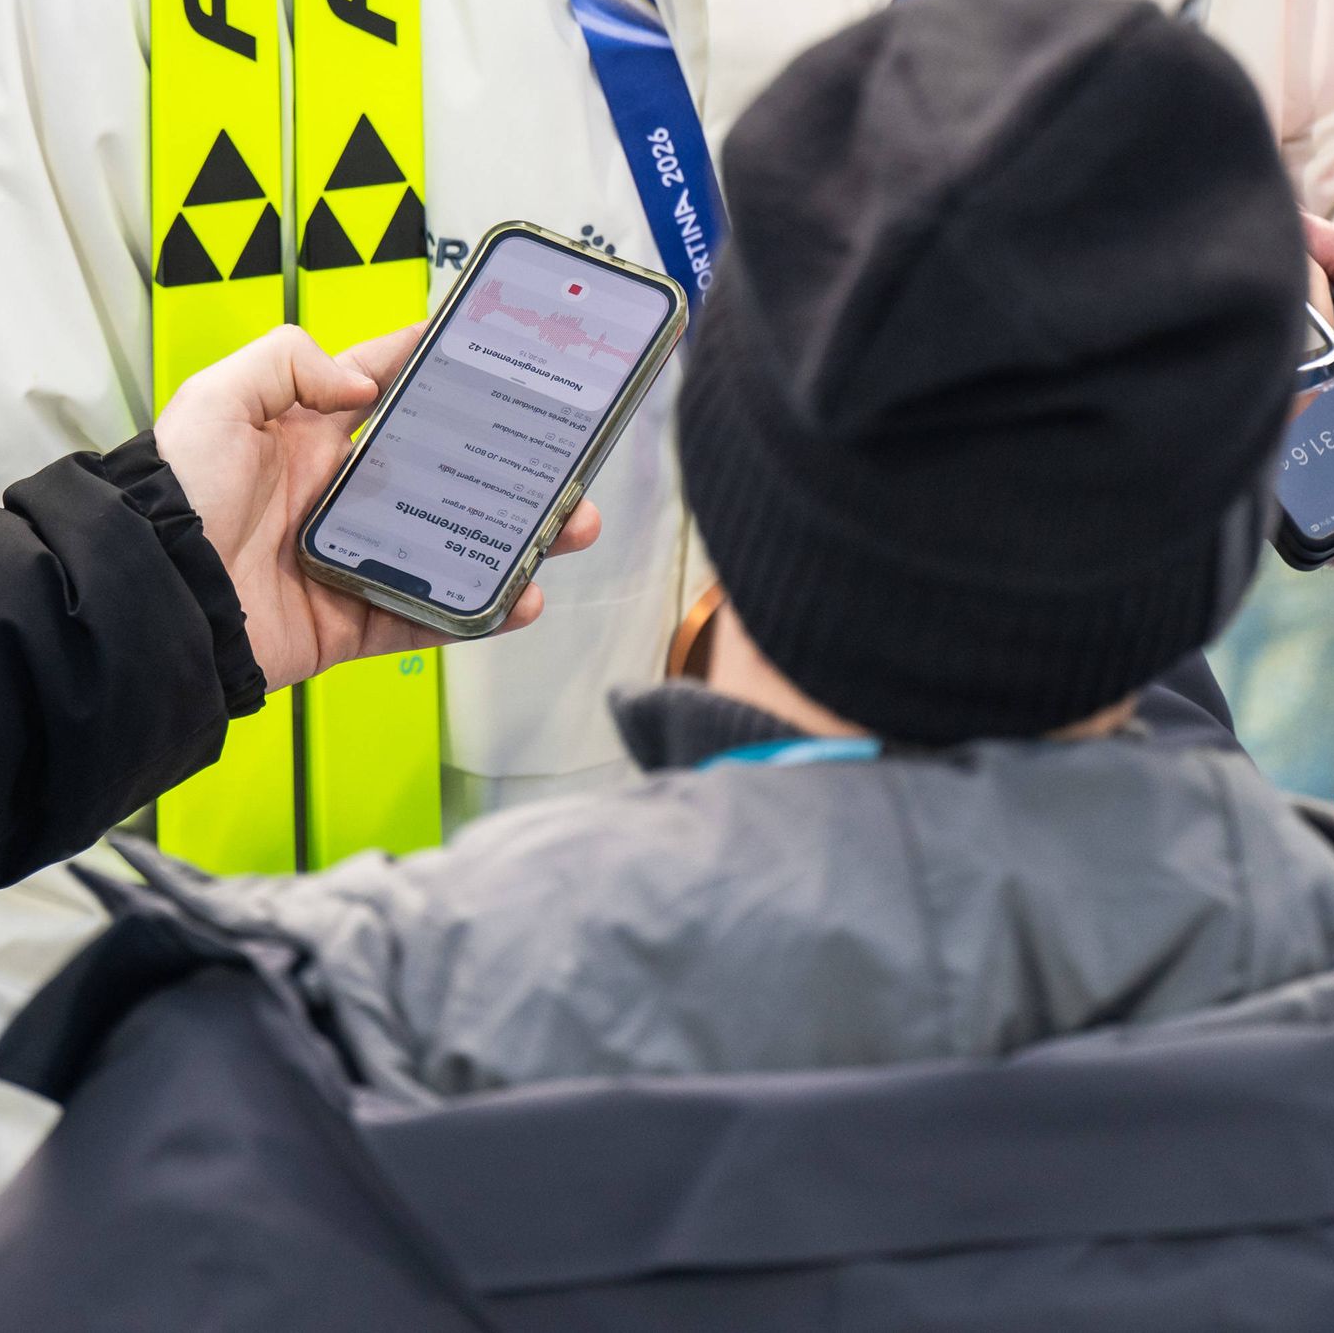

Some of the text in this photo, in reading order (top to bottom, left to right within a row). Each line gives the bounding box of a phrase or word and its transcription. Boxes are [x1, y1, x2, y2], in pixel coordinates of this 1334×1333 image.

[647, 127, 685, 188] 2026
[468, 341, 584, 392] Nouvel enregistrement 42
[490, 389, 512, 403] 10.02
[511, 398, 544, 415] individuel
[491, 422, 529, 442] individuel
[565, 419, 587, 432] QFM
[528, 436, 546, 448] jack
[486, 452, 499, 461] JO
[498, 456, 522, 471] Mazet
[455, 471, 482, 485] argent
[521, 465, 556, 484] Siegfried
[481, 481, 516, 500] Fourcade
[441, 497, 467, 511] argent
[515, 495, 540, 509] Simon
[395, 501, 513, 553] enregistrements
[484, 514, 509, 529] Perrot
[337, 547, 348, 555] 5G
[444, 540, 501, 572] Tous les
[445, 590, 466, 603] 16:14
